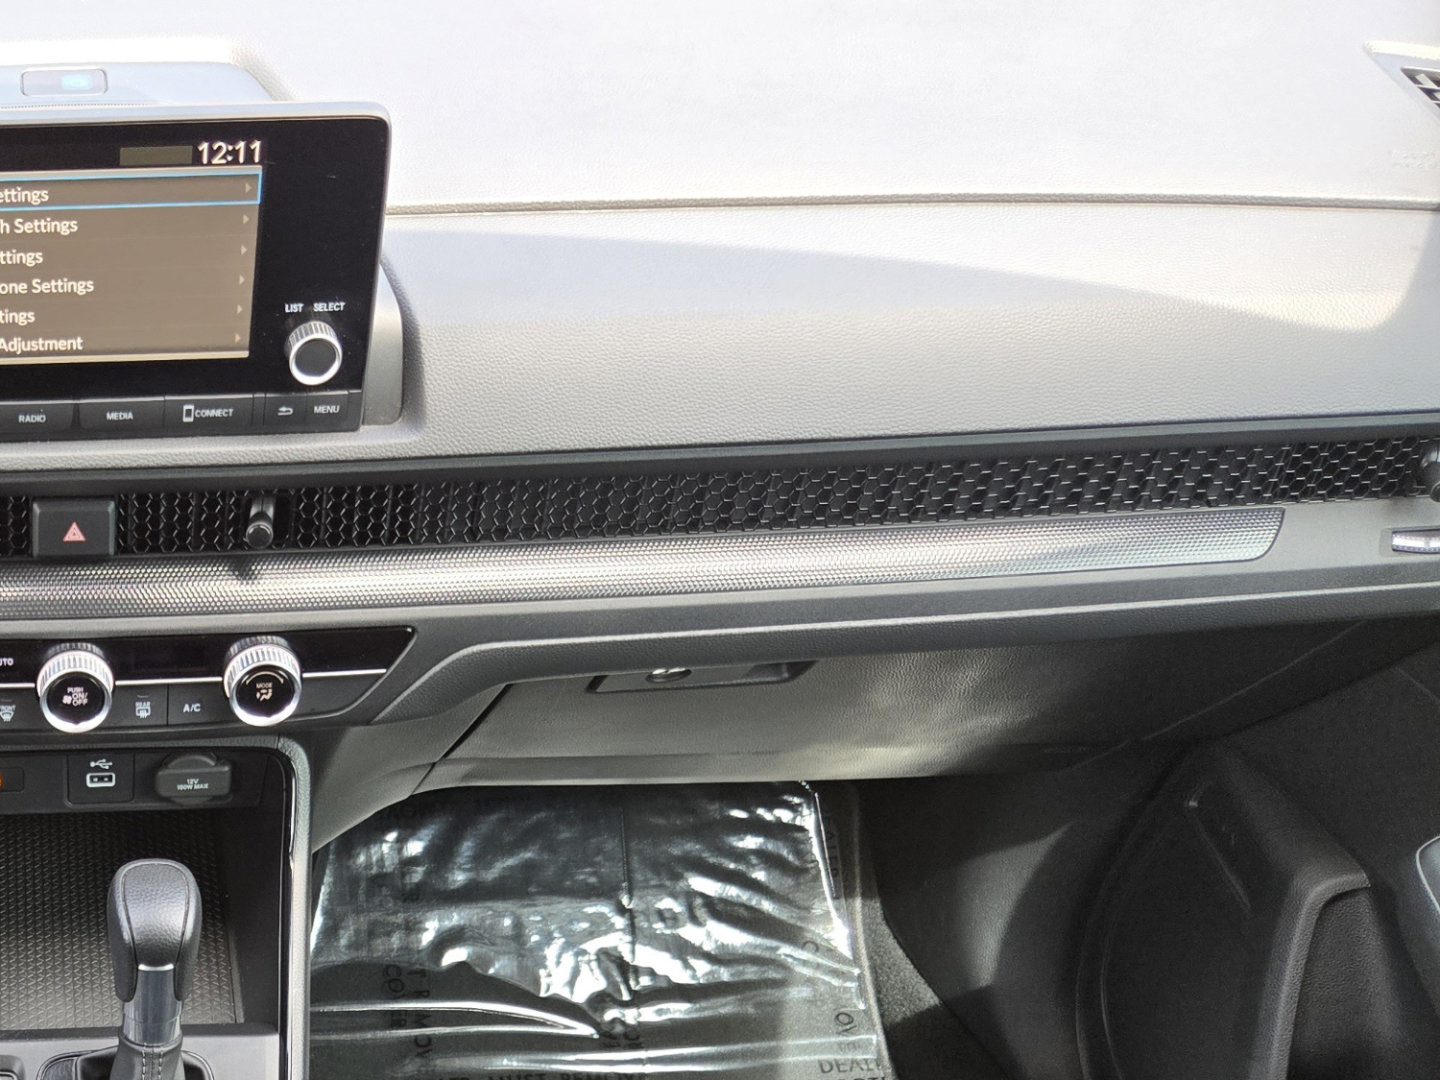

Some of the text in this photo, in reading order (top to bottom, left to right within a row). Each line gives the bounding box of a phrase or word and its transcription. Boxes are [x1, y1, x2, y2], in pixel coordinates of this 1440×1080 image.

[197, 140, 262, 165] 12:11
[13, 216, 79, 235] Settings
[31, 276, 95, 296] Settings
[284, 301, 346, 314] LIST SELECT
[194, 408, 234, 419] CONNECT
[313, 405, 341, 415] MENU
[18, 413, 47, 424] RADIO
[106, 411, 134, 421] MEDIA
[67, 686, 85, 694] PUSH
[255, 682, 273, 690] MODE
[72, 698, 89, 707] OFF
[182, 703, 201, 713] A/C
